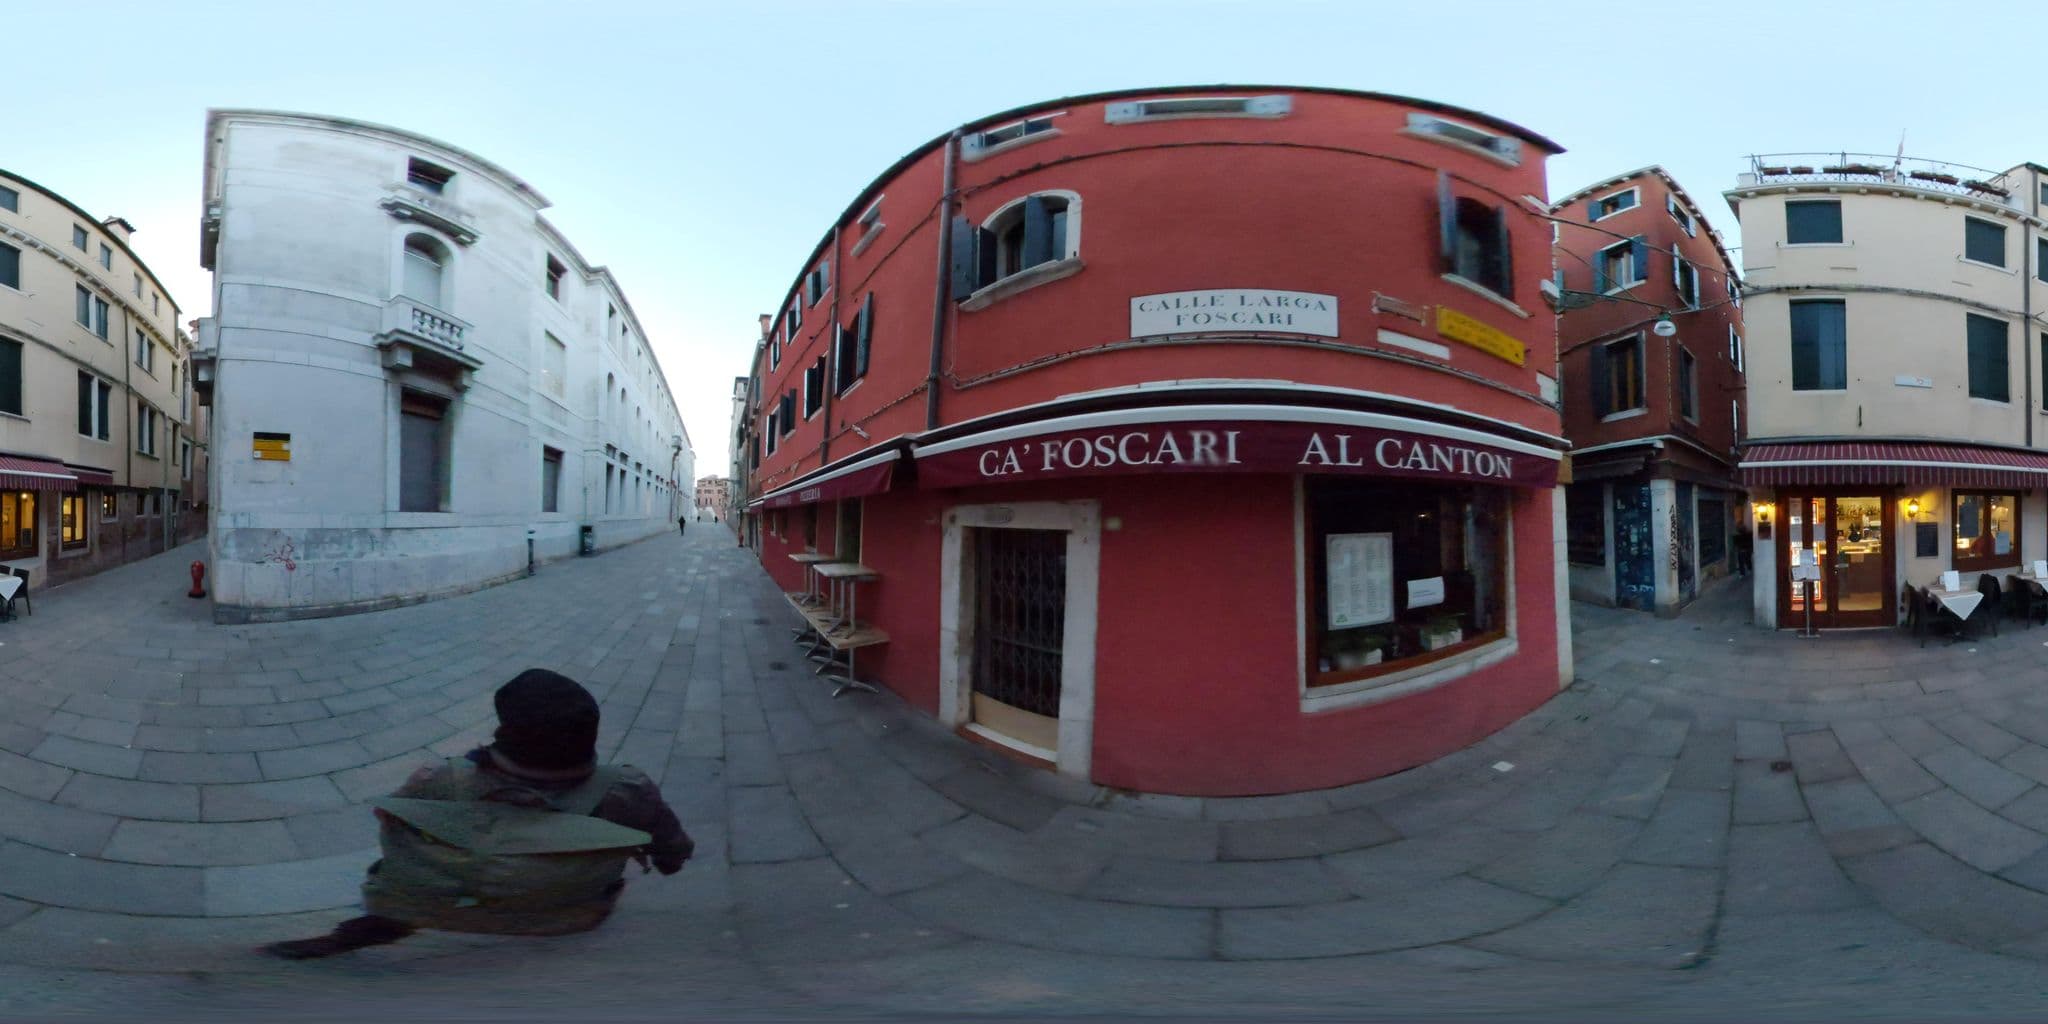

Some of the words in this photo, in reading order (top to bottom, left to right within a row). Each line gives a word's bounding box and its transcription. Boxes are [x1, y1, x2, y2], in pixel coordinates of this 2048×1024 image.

[1139, 295, 1224, 313] CALLE
[1240, 294, 1328, 312] LARGA
[1176, 312, 1297, 327] FOSCARI
[979, 444, 1030, 476] CA'
[1040, 430, 1242, 471] FOSCARI
[1298, 432, 1364, 467] AL
[1375, 438, 1513, 479] CANTON
